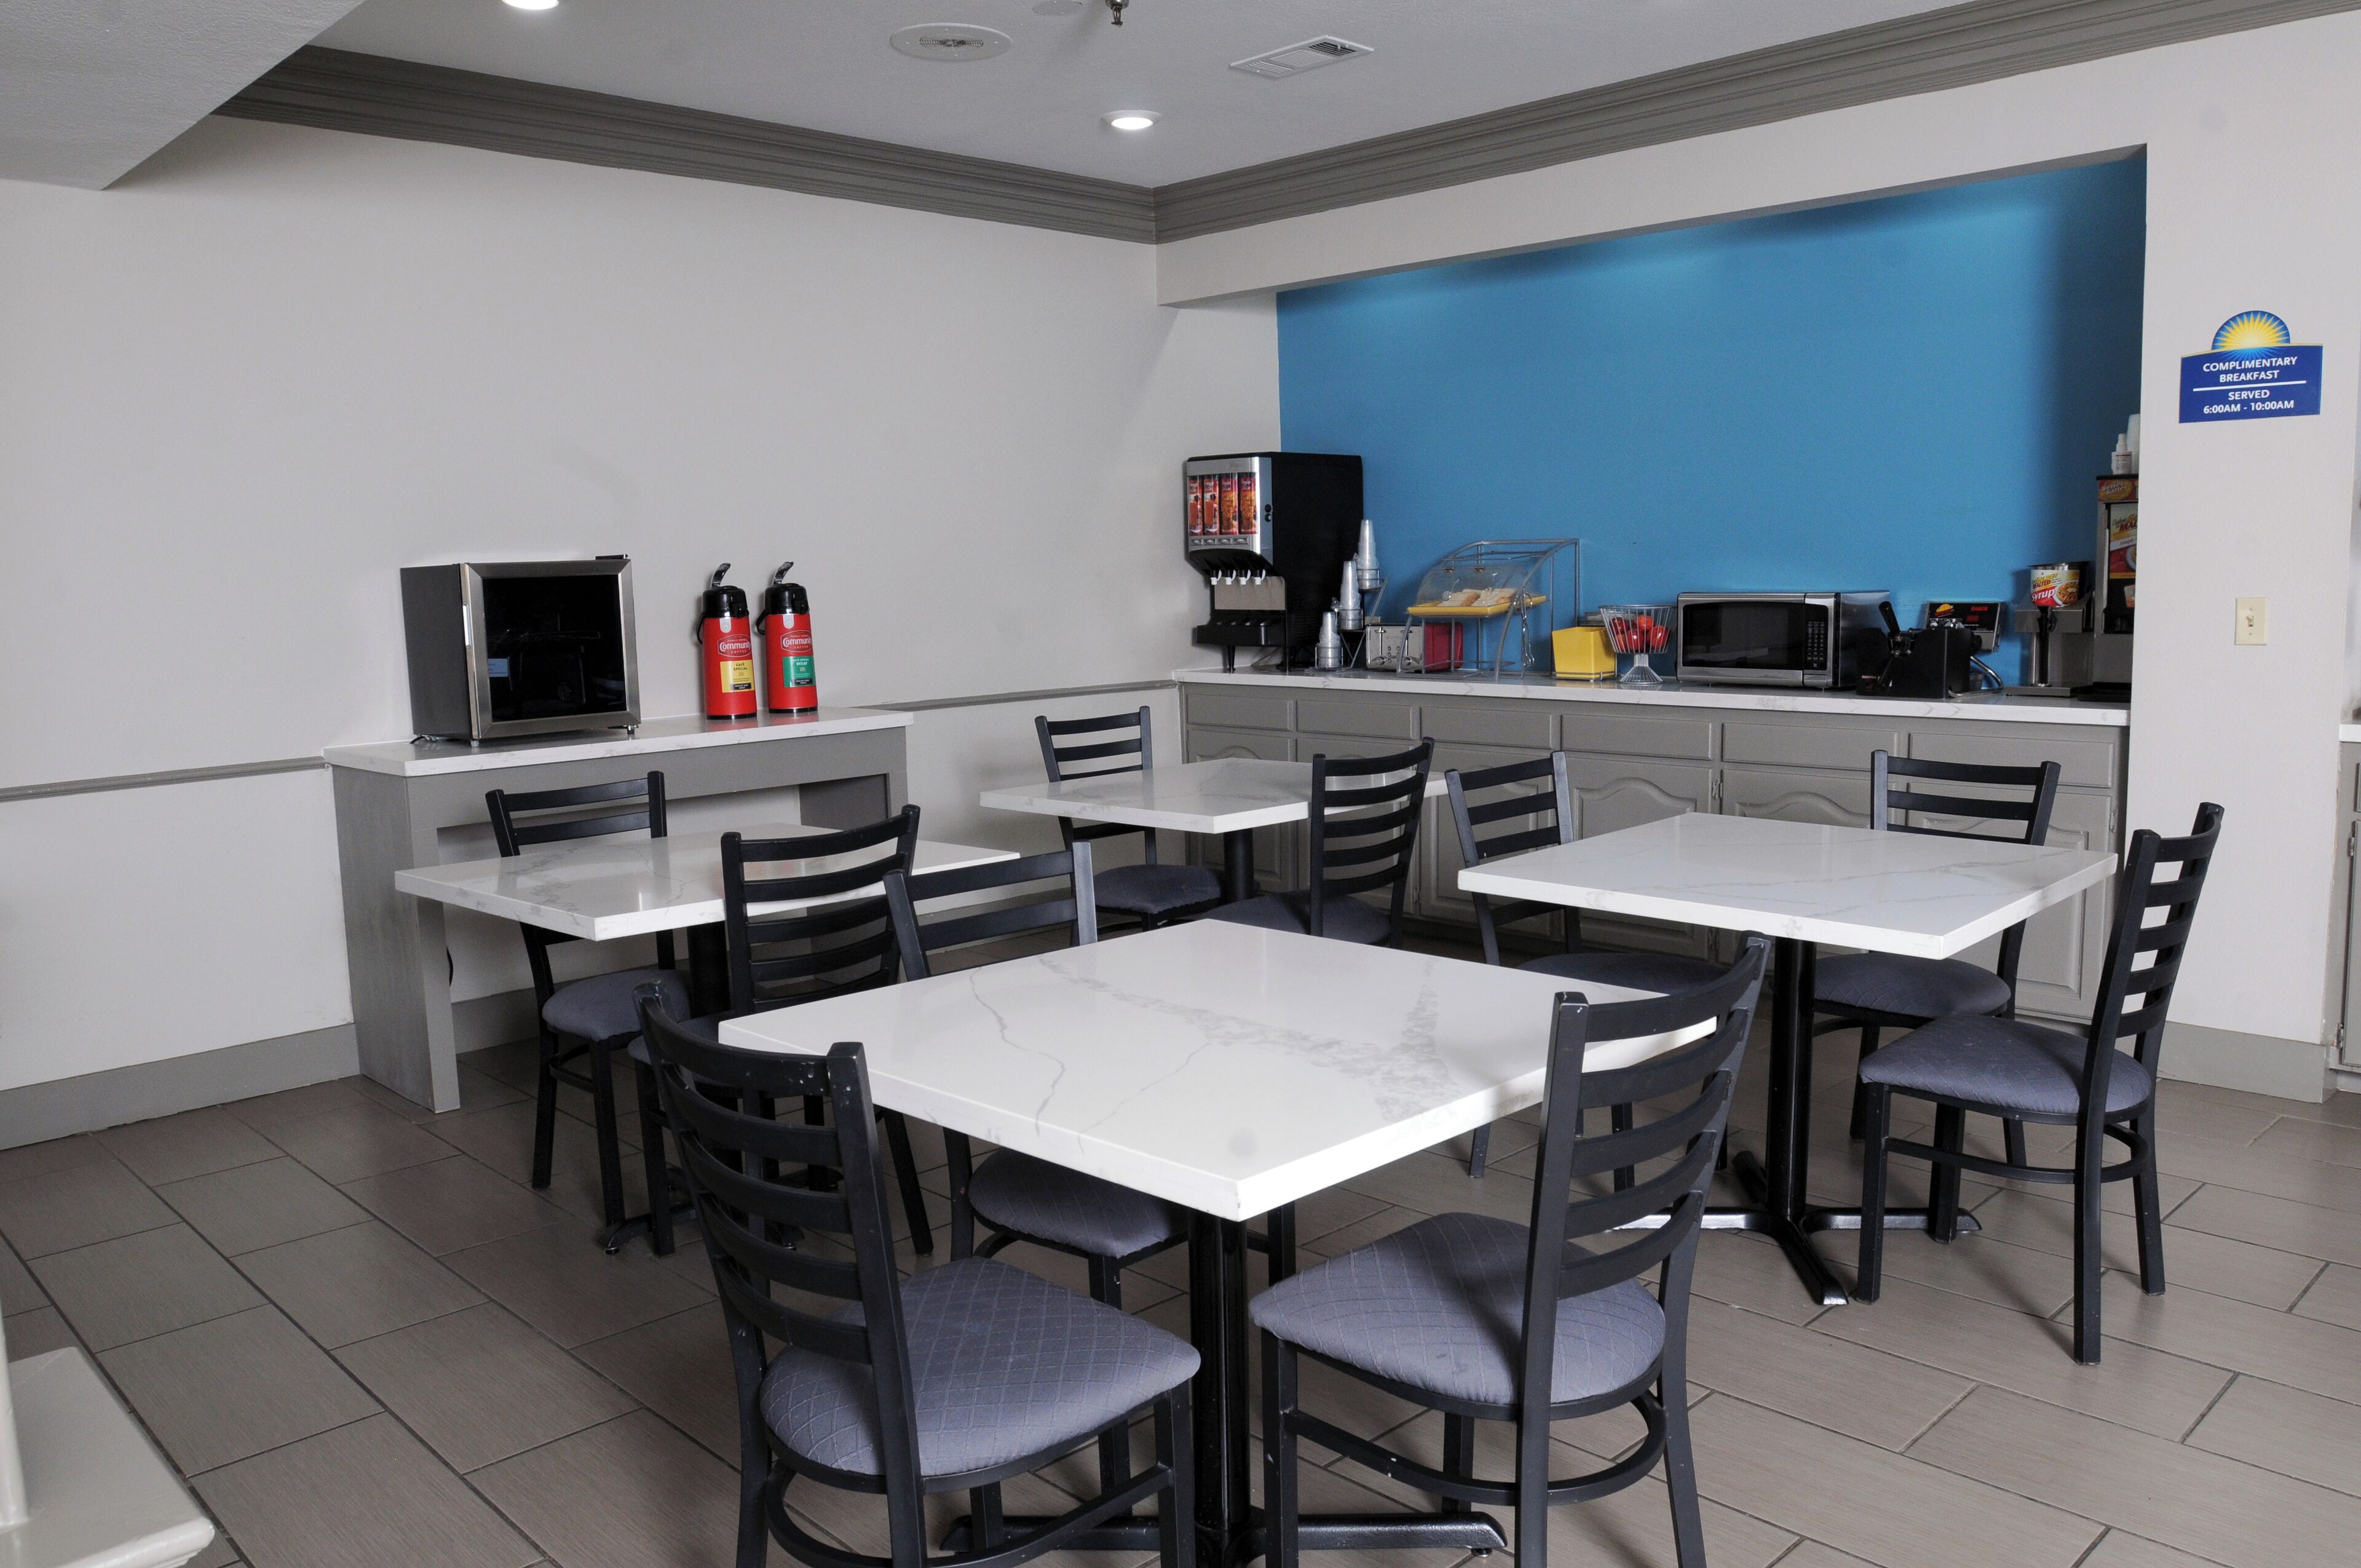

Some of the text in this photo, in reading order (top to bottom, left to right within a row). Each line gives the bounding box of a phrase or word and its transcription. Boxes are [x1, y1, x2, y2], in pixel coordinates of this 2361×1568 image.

[2203, 356, 2298, 372] COMPLIMENTARY
[2220, 370, 2280, 382] BREAKFAST
[2228, 389, 2271, 400] SERVED
[2203, 403, 2241, 414] 6:00AM
[2250, 400, 2295, 411] 10:00AM
[2031, 589, 2055, 602] Syrup
